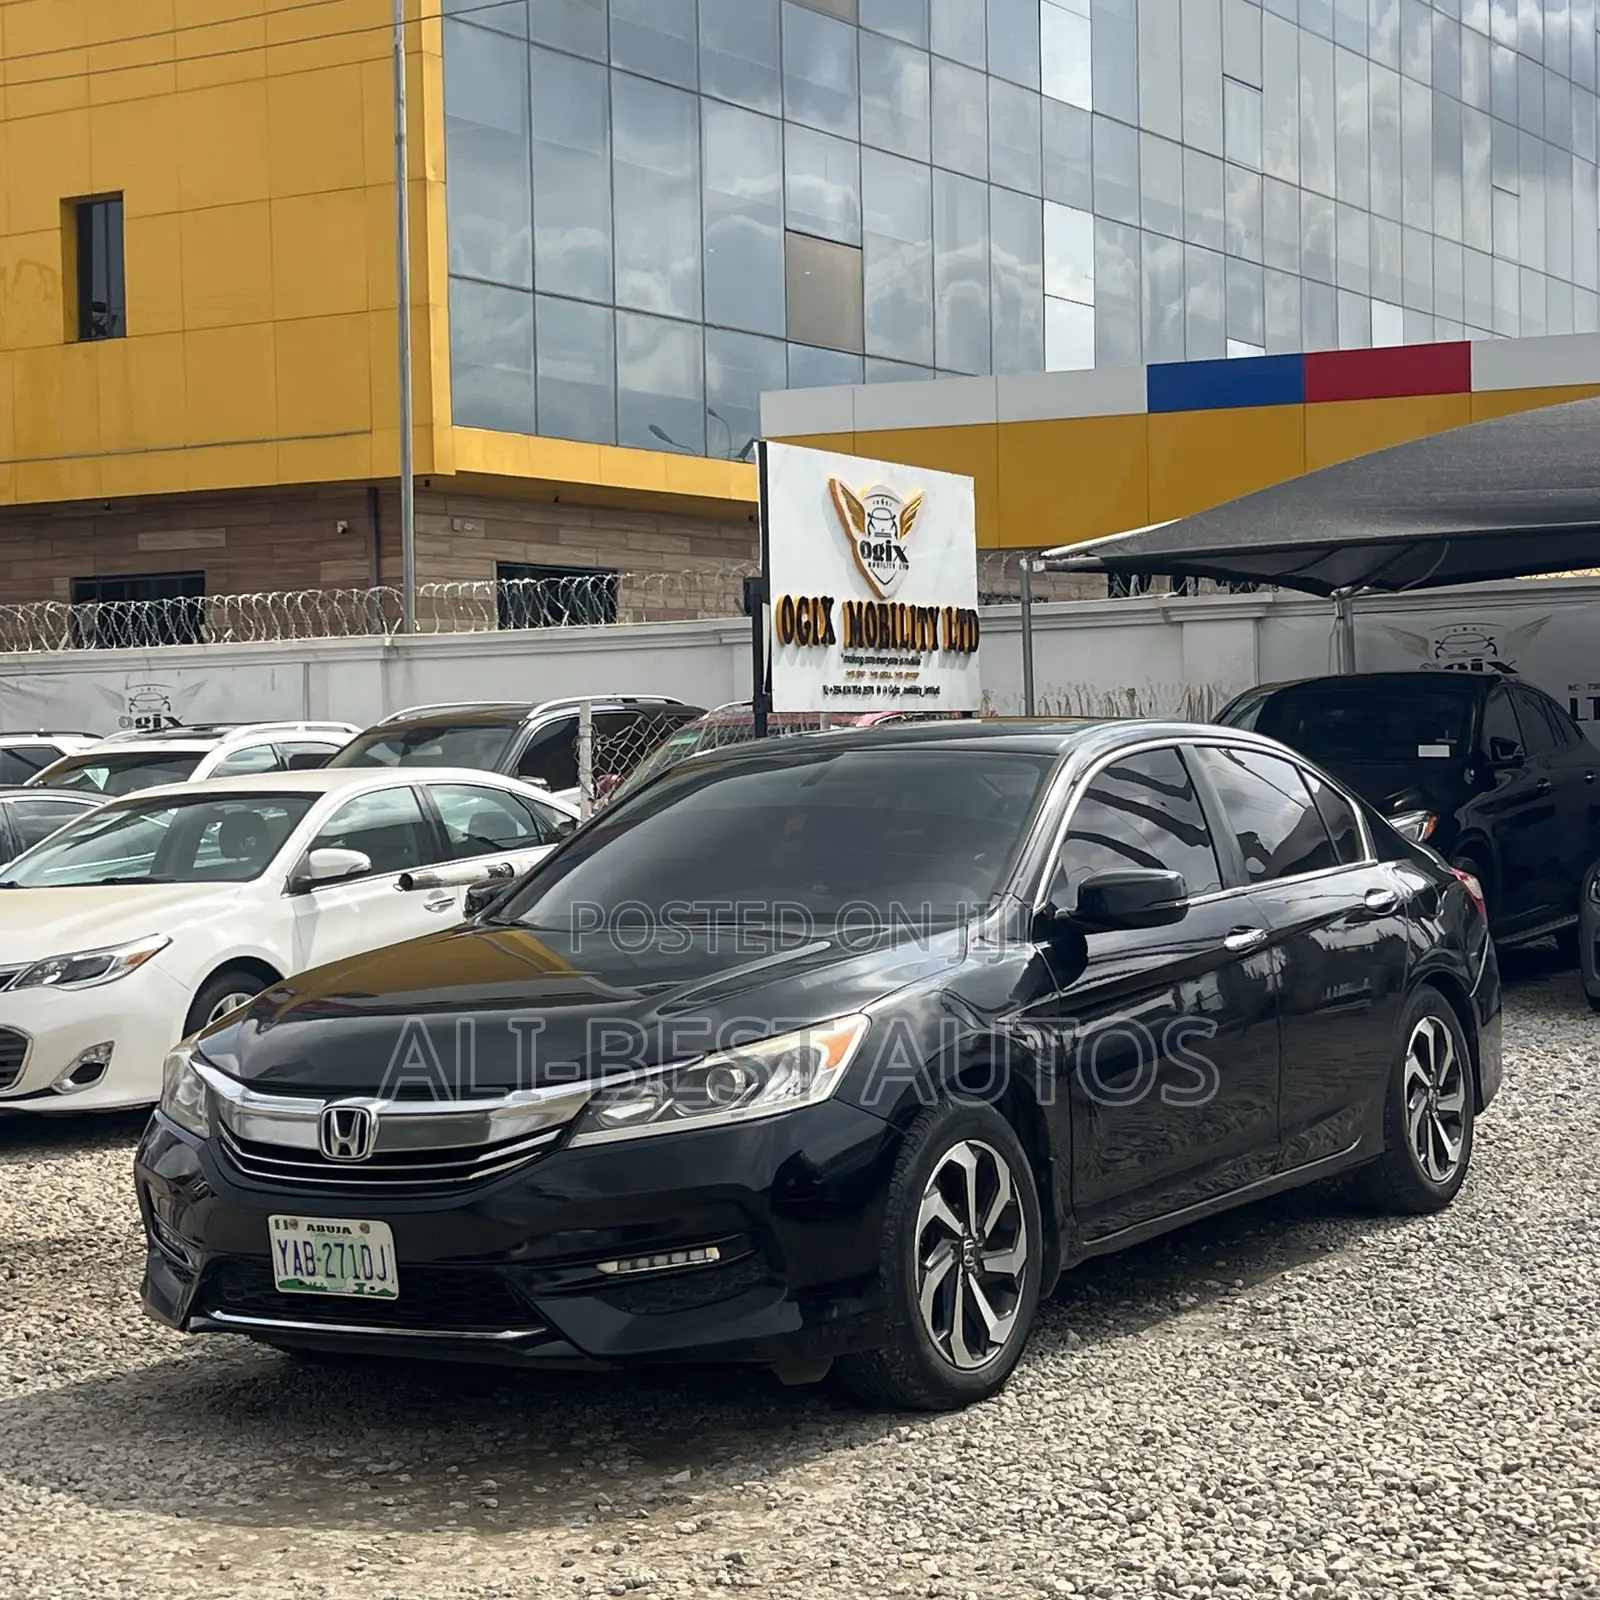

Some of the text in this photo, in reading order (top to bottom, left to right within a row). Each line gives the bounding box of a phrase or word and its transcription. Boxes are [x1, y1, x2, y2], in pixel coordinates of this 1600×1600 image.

[776, 594, 980, 653] OGIX MOBILITY LTD
[306, 1223, 352, 1235] ABUJA
